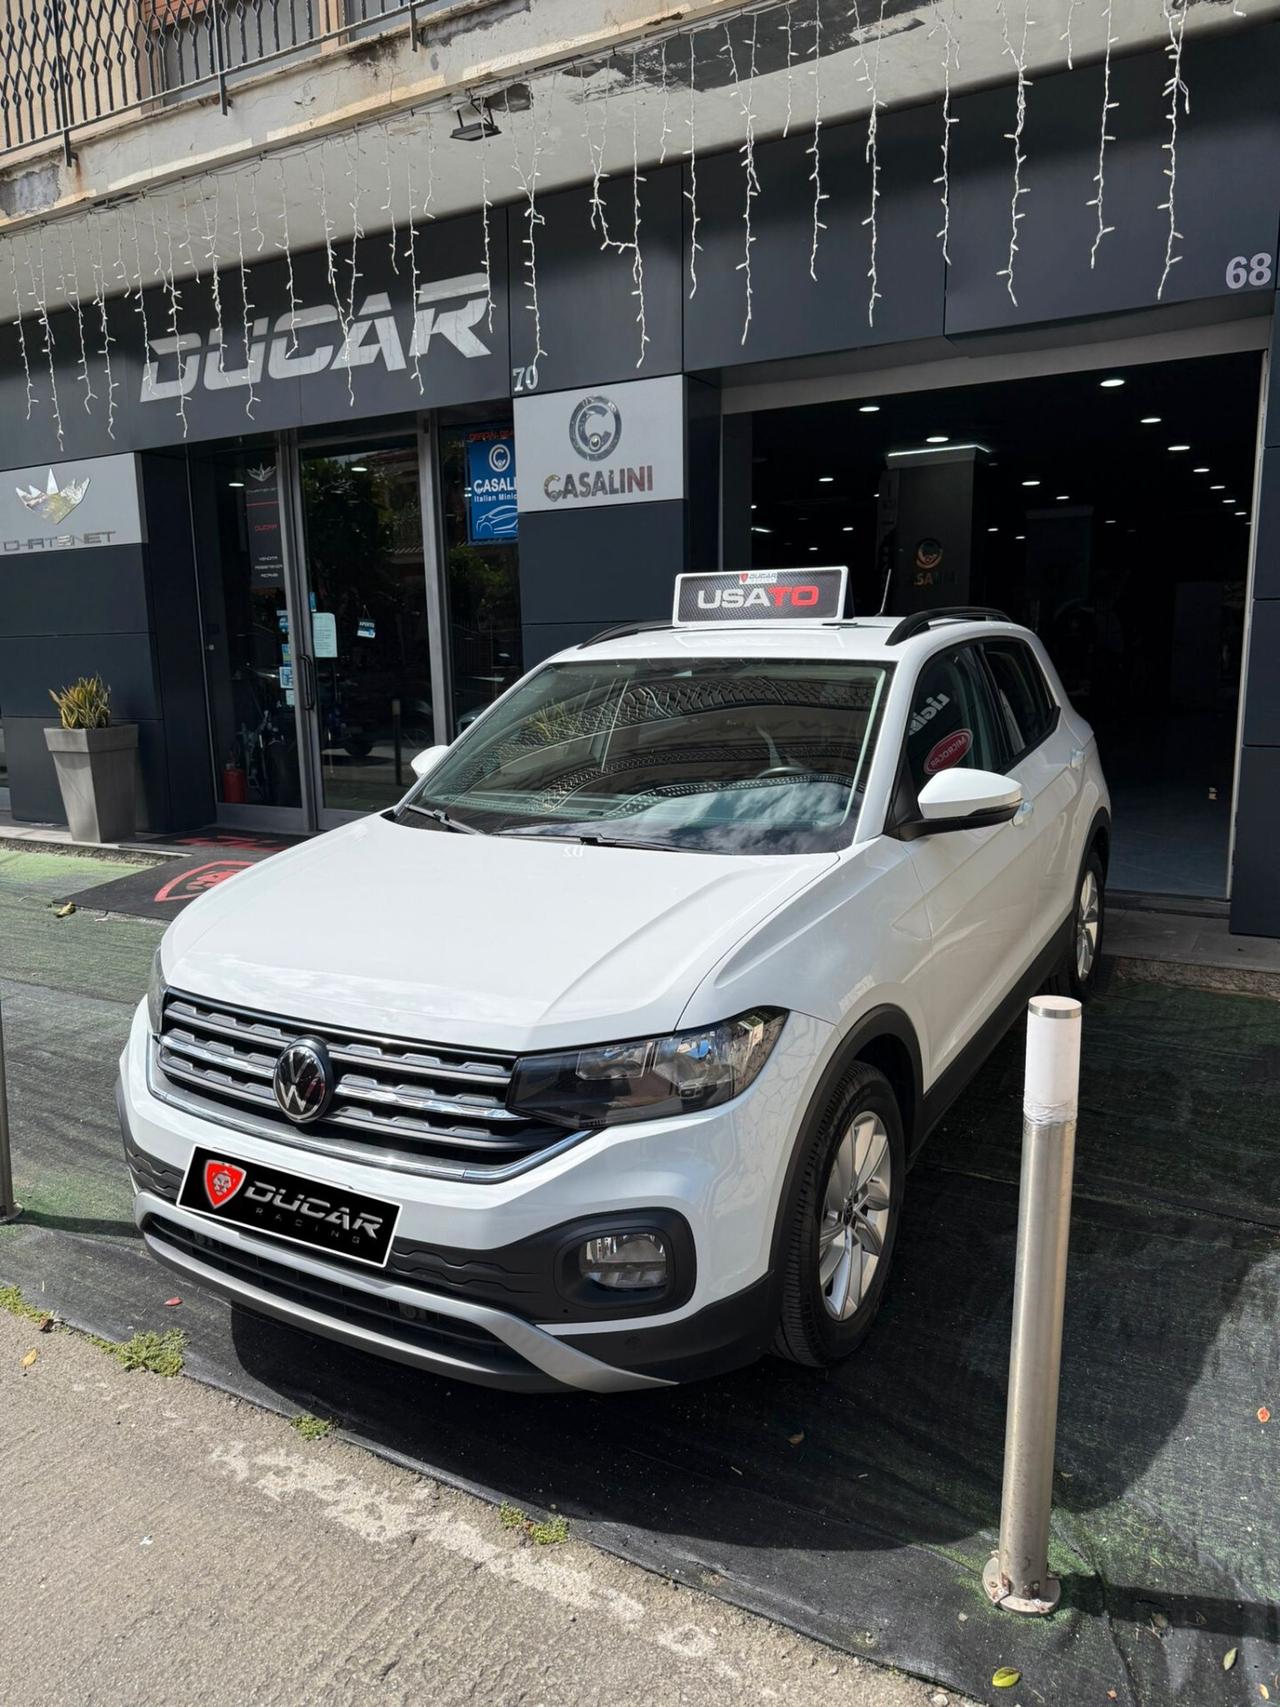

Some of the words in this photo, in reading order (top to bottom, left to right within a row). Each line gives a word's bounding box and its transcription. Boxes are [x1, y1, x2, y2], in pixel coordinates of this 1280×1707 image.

[1225, 252, 1272, 289] 68
[139, 272, 492, 403] DUCAR
[512, 365, 539, 392] 70
[474, 495, 496, 503] Italian
[543, 465, 654, 502] CASALINI
[697, 585, 820, 609] USATO
